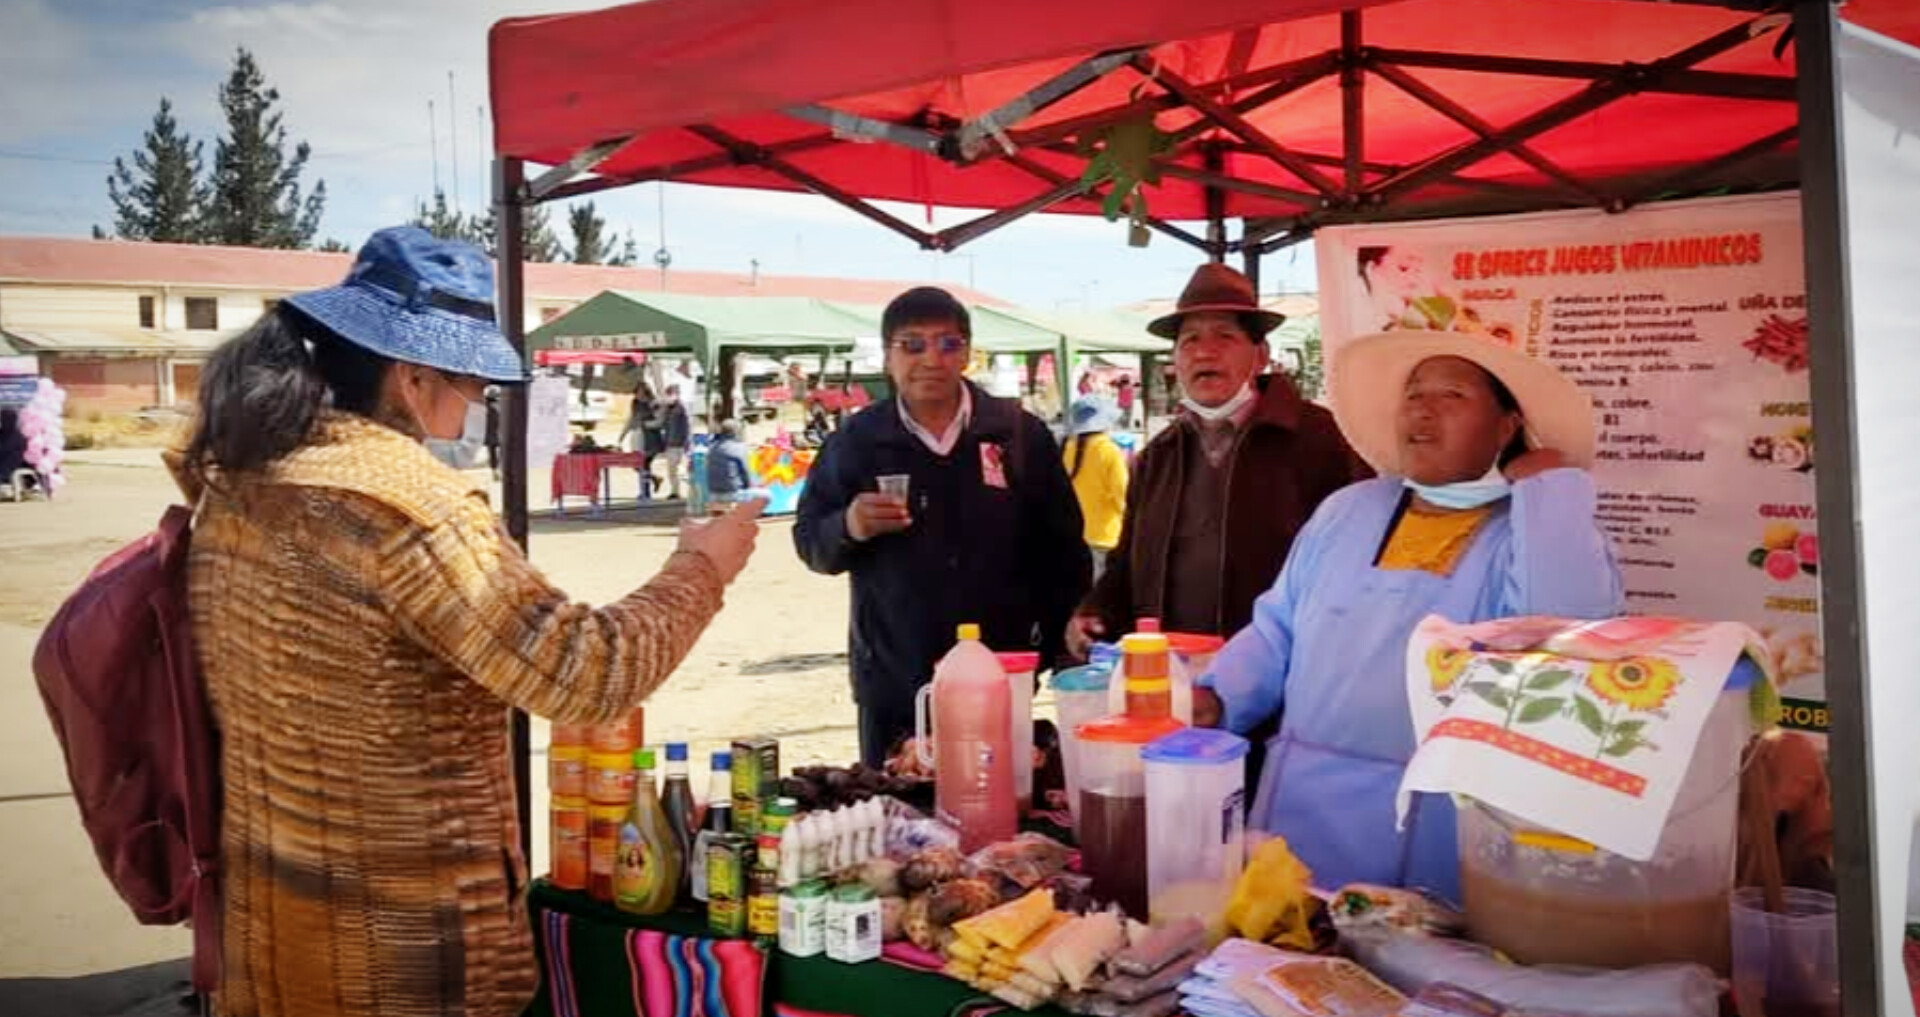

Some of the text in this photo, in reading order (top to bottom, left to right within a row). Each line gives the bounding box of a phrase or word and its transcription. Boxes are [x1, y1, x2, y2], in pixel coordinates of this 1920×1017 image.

[1453, 233, 1761, 280] SE OFRECE JUGOS VITAMINICOS
[1628, 449, 1704, 462] infertilidad
